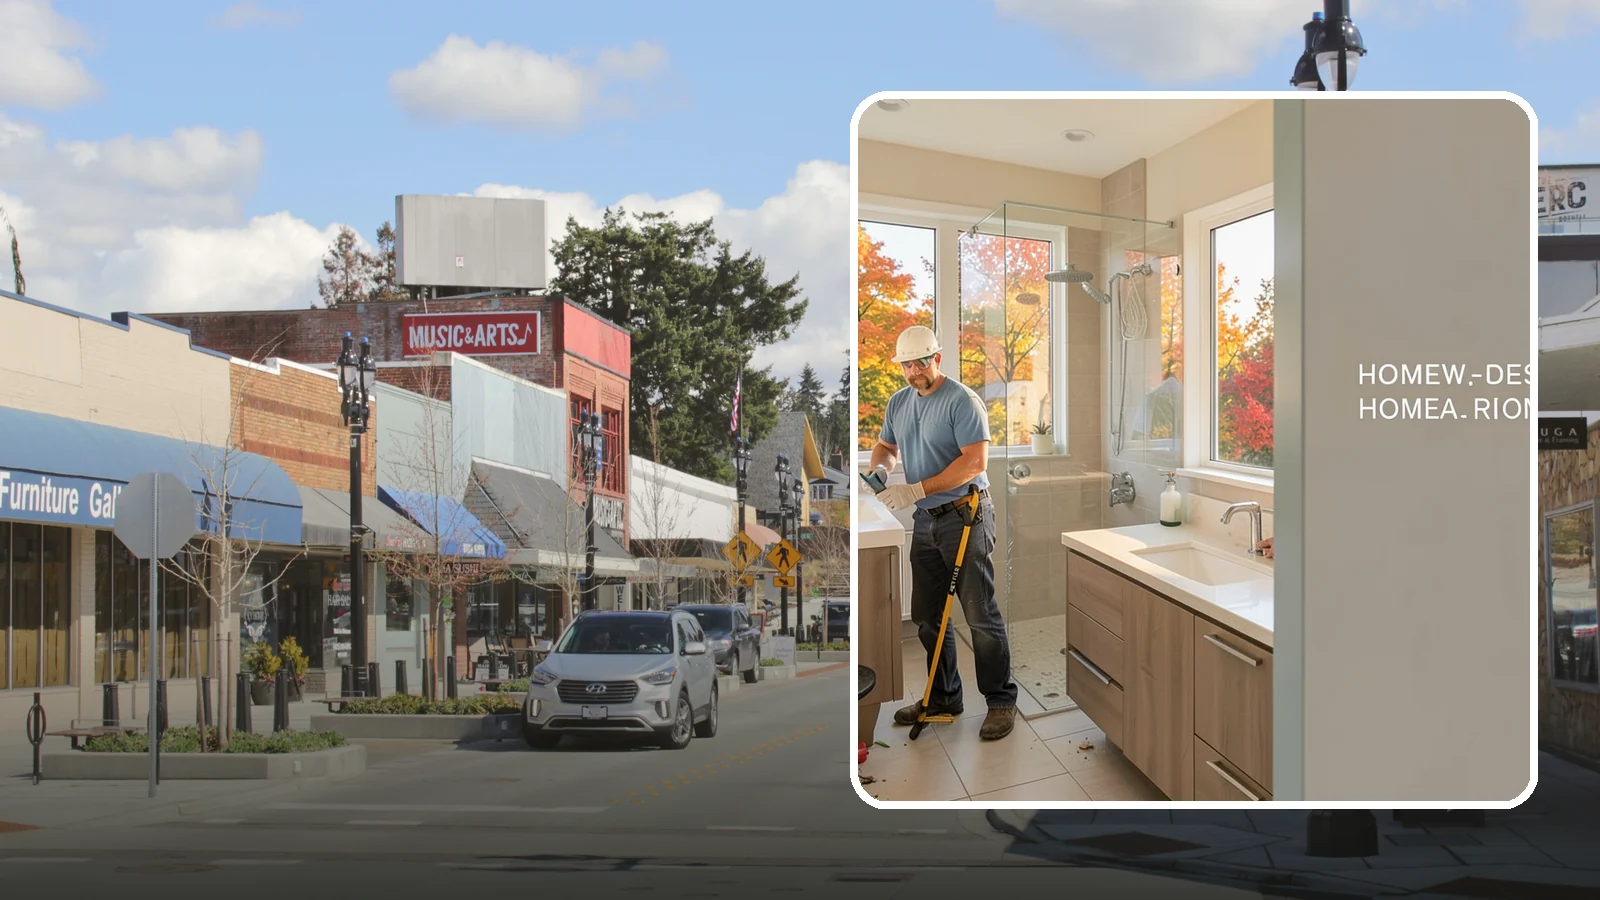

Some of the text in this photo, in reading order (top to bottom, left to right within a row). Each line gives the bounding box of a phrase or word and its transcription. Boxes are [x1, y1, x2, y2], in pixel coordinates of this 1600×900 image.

[409, 323, 519, 348] MUSIC&ARTS
[0, 471, 79, 516] Furniture
[453, 563, 480, 575] SUSHI
